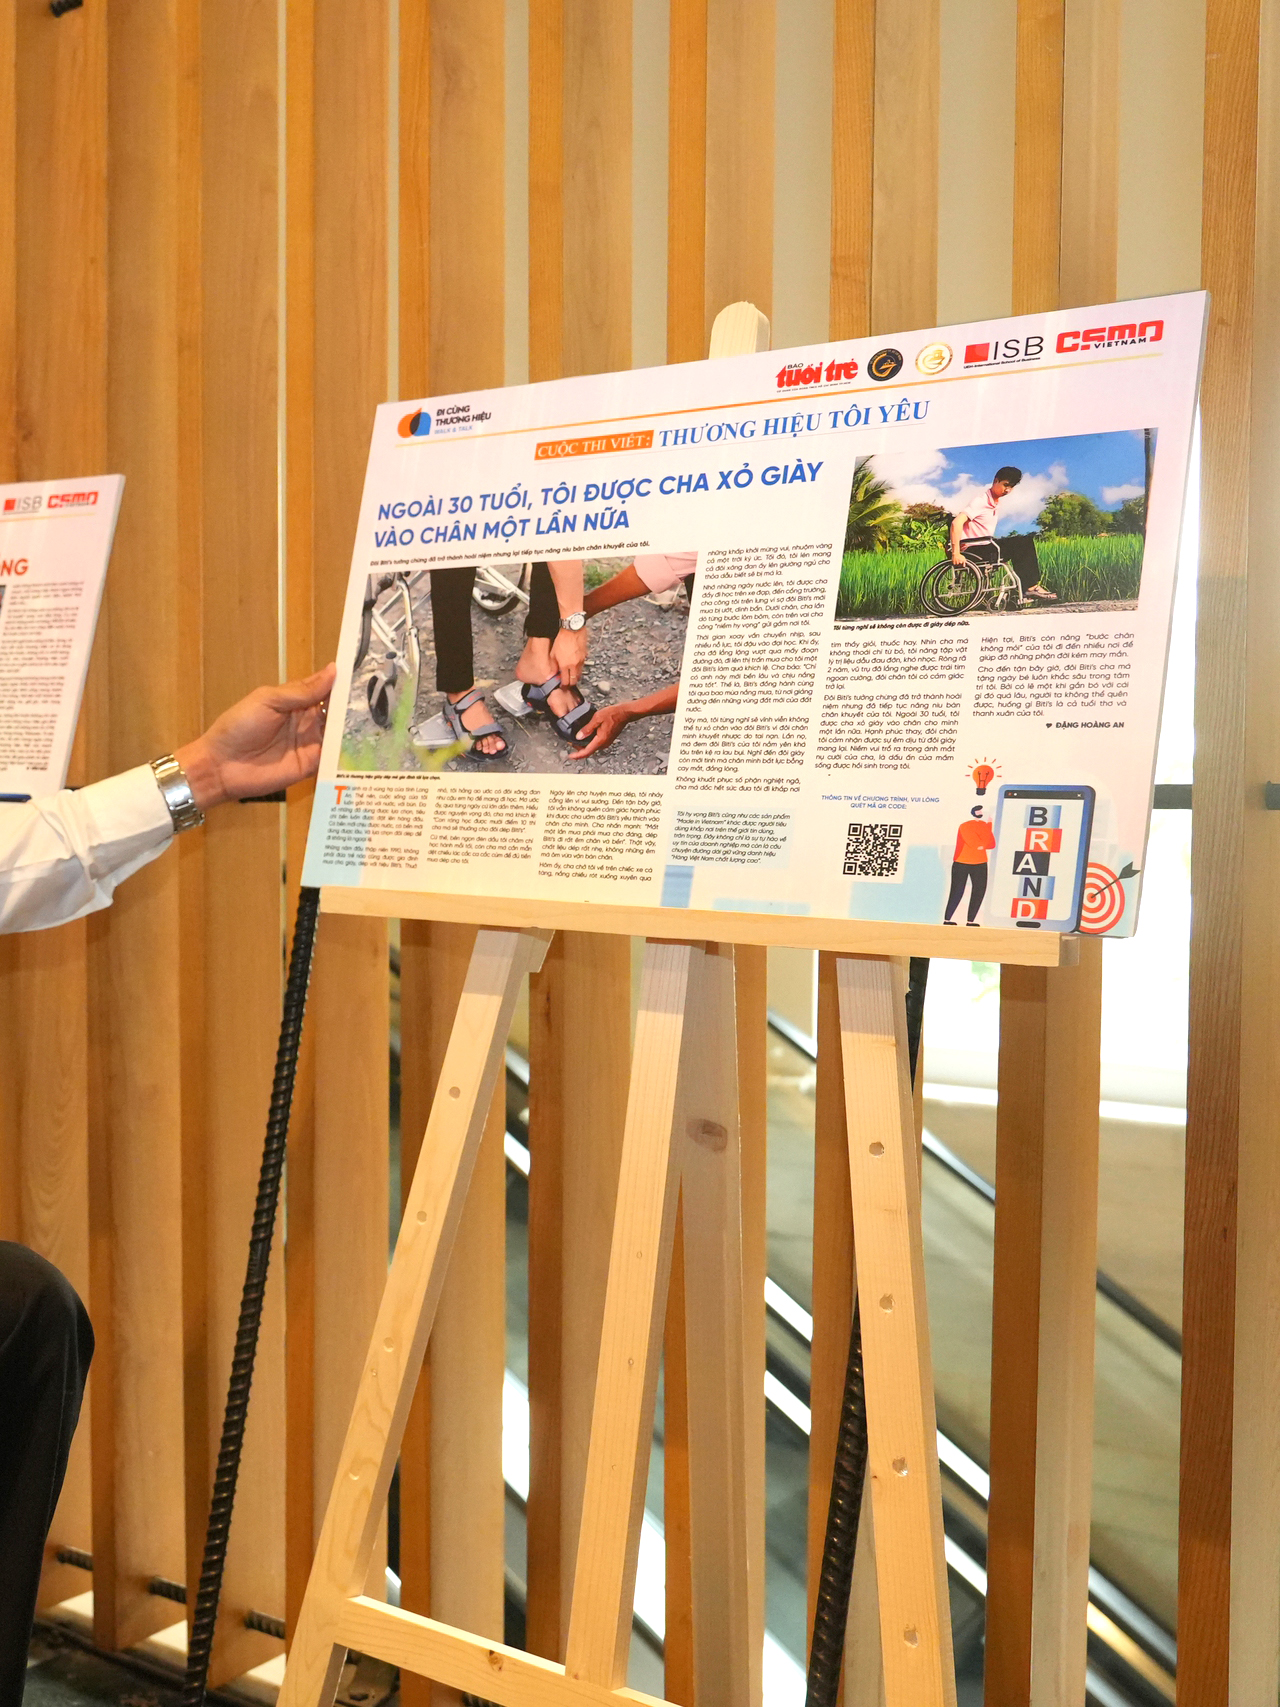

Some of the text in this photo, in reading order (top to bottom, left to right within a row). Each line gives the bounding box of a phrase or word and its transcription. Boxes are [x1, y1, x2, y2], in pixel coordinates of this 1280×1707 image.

[994, 336, 1044, 360] ISB
[1094, 337, 1146, 348] VIETNAM
[775, 362, 823, 388] tuổi
[824, 358, 858, 382] trẻ
[436, 405, 470, 416] ĐI CÙNG
[436, 411, 492, 426] THƯƠNG HIỆU
[660, 398, 929, 446] THƯƠNG HIỆU TÔI YÊU
[378, 458, 824, 520] NGOÀI 30 TUỔI, TÔI ĐƯỢC CHA XỎ GIÀY
[375, 506, 629, 548] VÀO CHÂN MỘT LẦN NỮA
[981, 636, 998, 644] Hiện
[1003, 635, 1014, 644] tại,
[1060, 633, 1081, 642] nâng
[980, 644, 1004, 653] không
[1065, 641, 1081, 649] đến
[1083, 640, 1105, 649] nhiều
[979, 653, 996, 662] giúp
[1010, 652, 1034, 661] những
[1035, 652, 1055, 661] phận
[1109, 650, 1128, 658] mắn.
[1056, 721, 1079, 730] ĐẶNG
